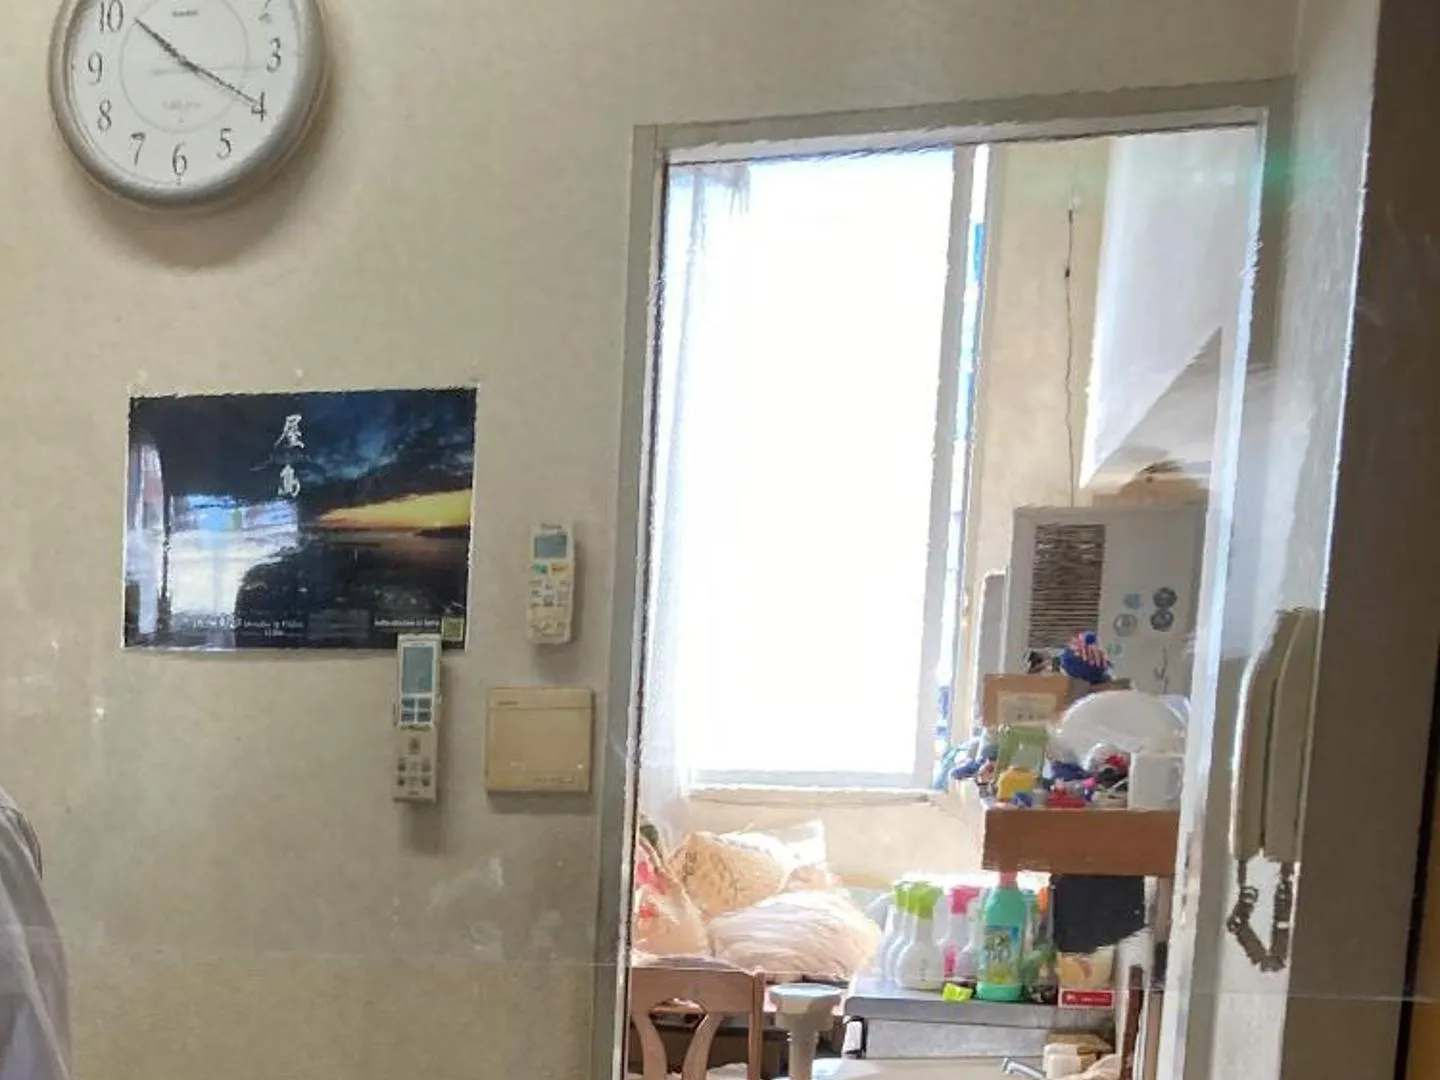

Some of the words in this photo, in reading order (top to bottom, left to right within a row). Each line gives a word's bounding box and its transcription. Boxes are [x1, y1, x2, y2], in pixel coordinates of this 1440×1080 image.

[99, 0, 124, 33] 10
[87, 51, 103, 85] 9
[266, 37, 281, 73] 3
[96, 99, 112, 132] 8
[250, 92, 267, 121] 4
[130, 132, 146, 165] 7
[171, 142, 188, 176] 6
[216, 128, 232, 160] 5
